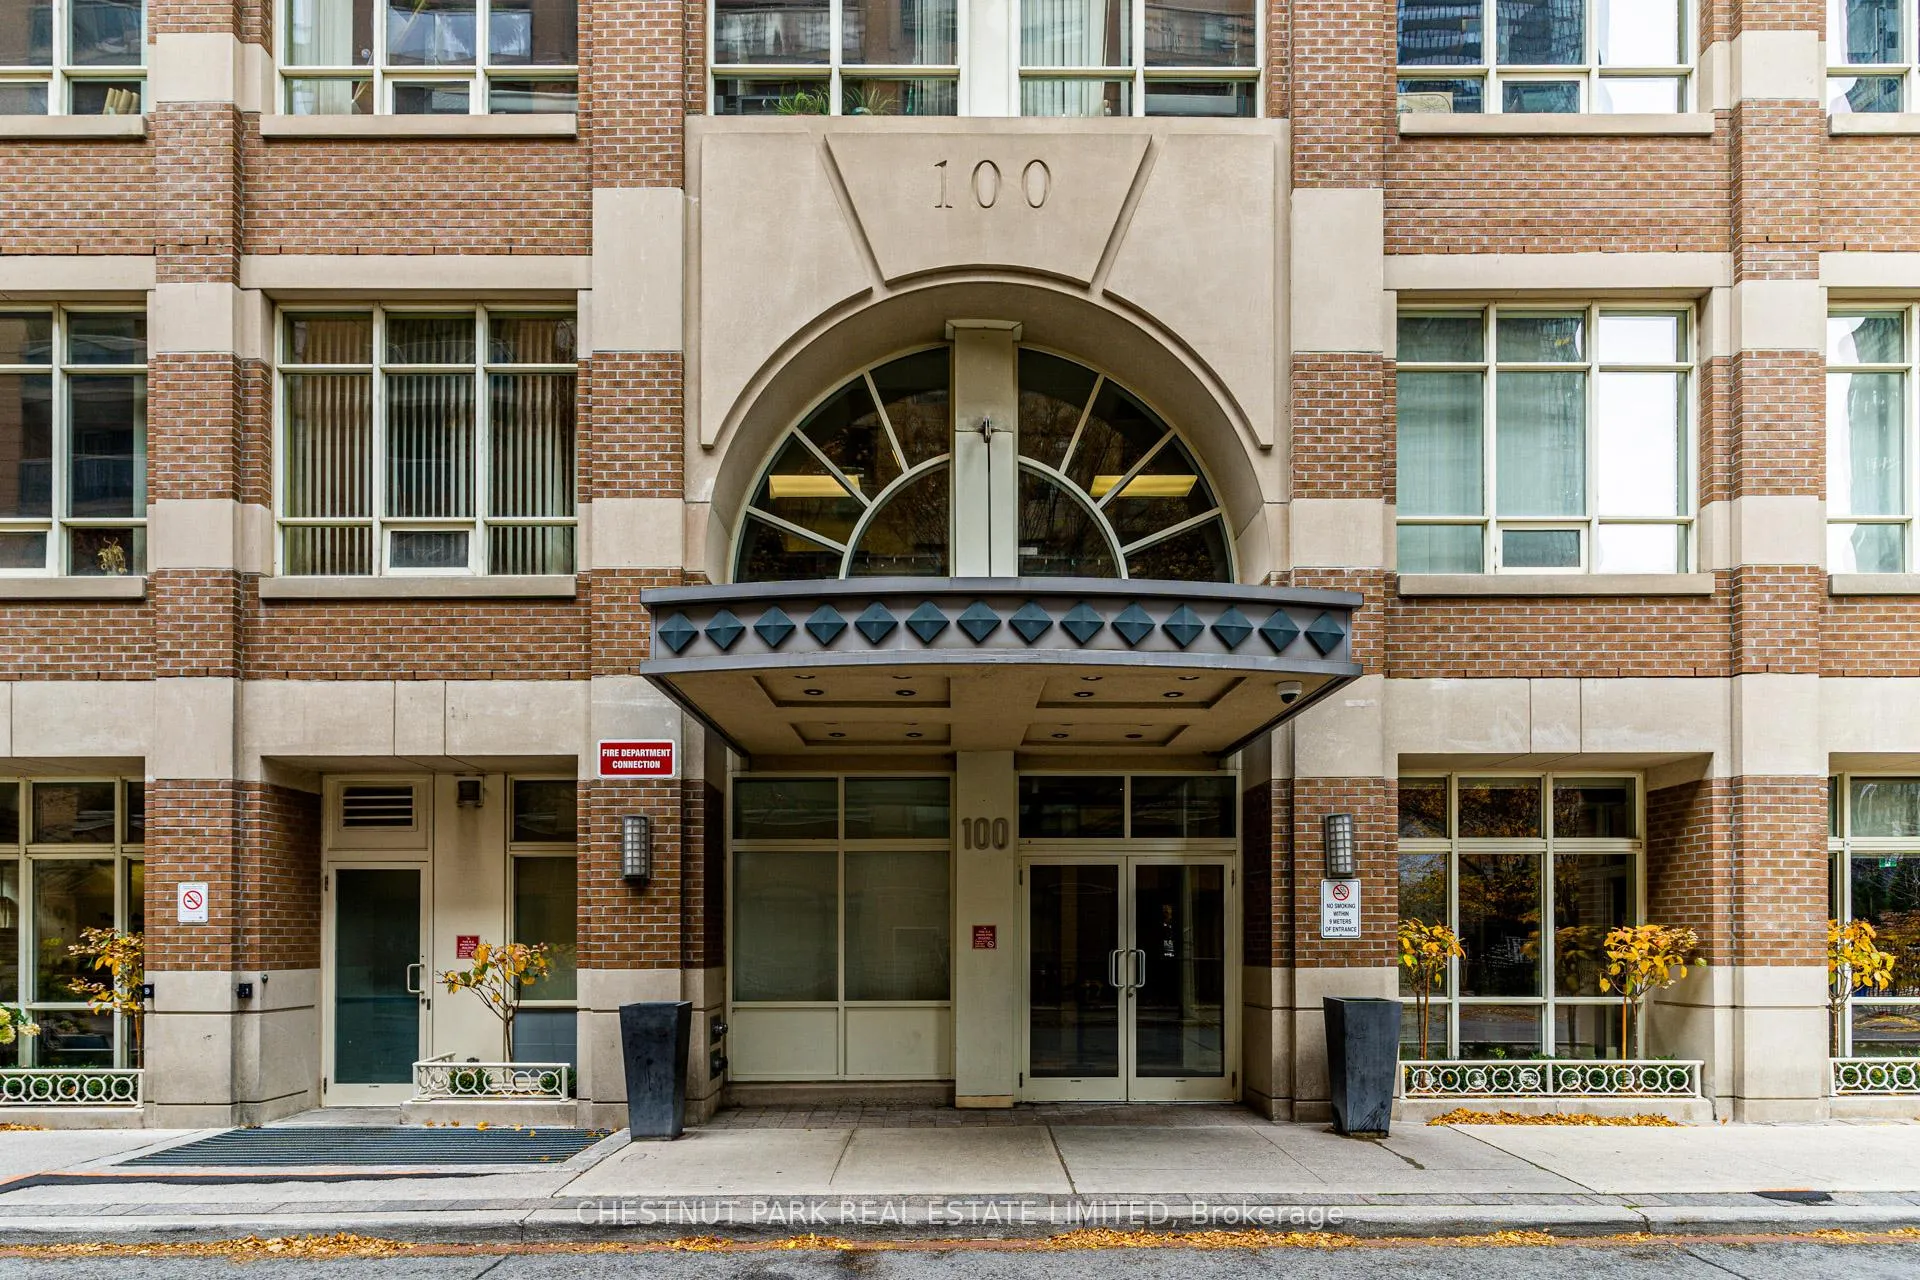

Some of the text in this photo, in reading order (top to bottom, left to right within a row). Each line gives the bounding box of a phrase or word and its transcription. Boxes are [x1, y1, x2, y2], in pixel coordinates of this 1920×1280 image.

[933, 159, 1052, 209] 100
[602, 748, 671, 757] FIRE DEPARTMENT
[612, 760, 660, 769] CONNECTION
[961, 817, 1010, 851] 100
